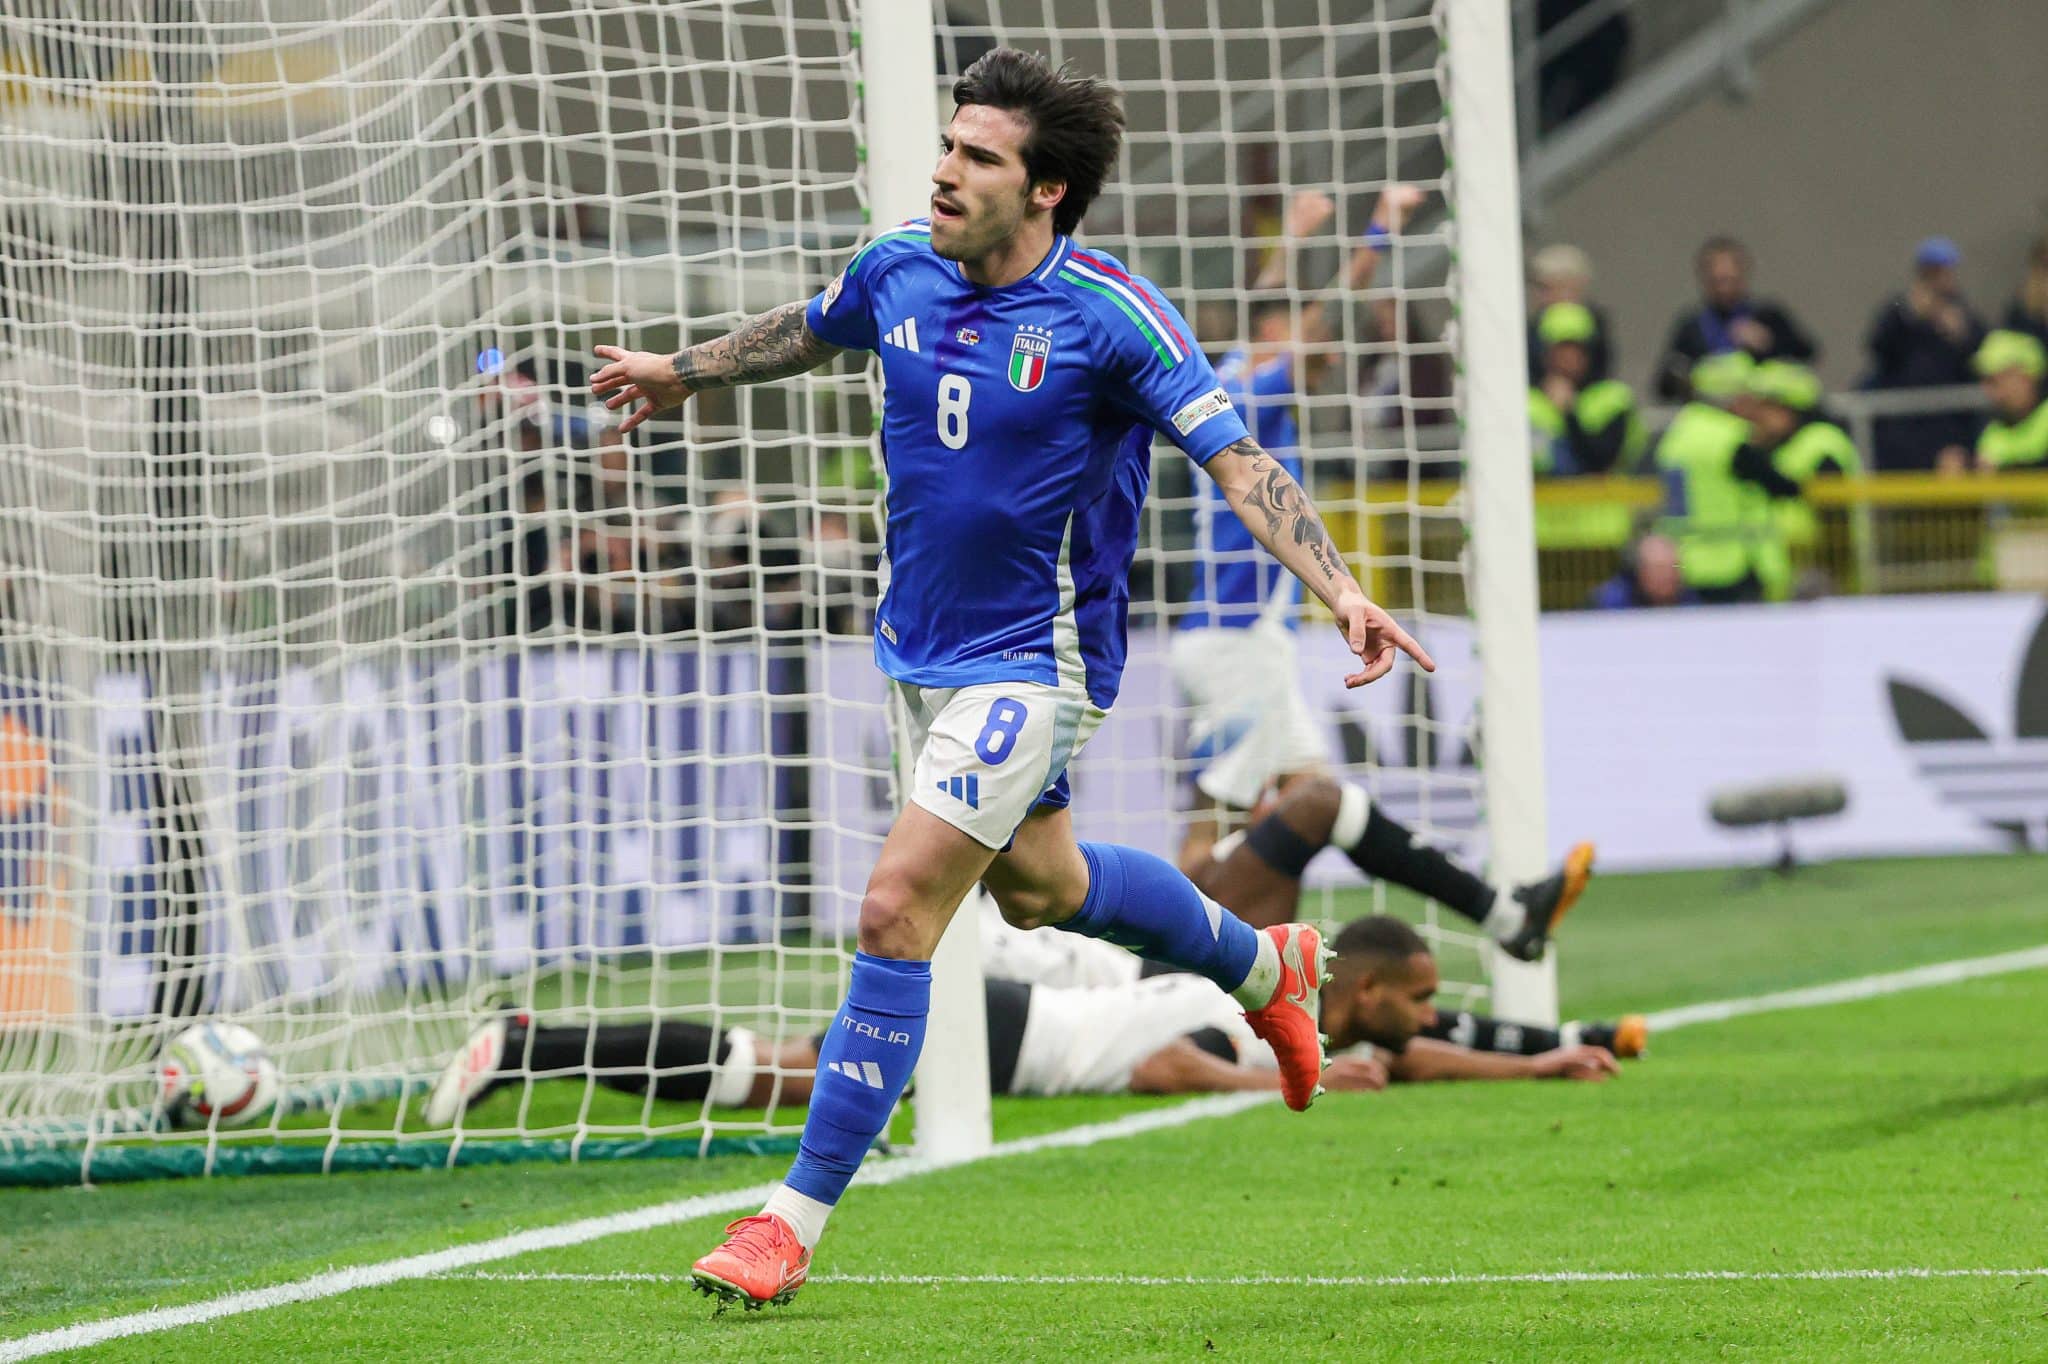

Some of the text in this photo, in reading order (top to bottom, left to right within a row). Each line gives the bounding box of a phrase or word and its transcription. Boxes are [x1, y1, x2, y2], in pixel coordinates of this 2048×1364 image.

[1016, 337, 1046, 354] ITALIA
[936, 374, 972, 450] 8
[974, 697, 1028, 766] 8
[842, 1015, 910, 1046] ITALIA
